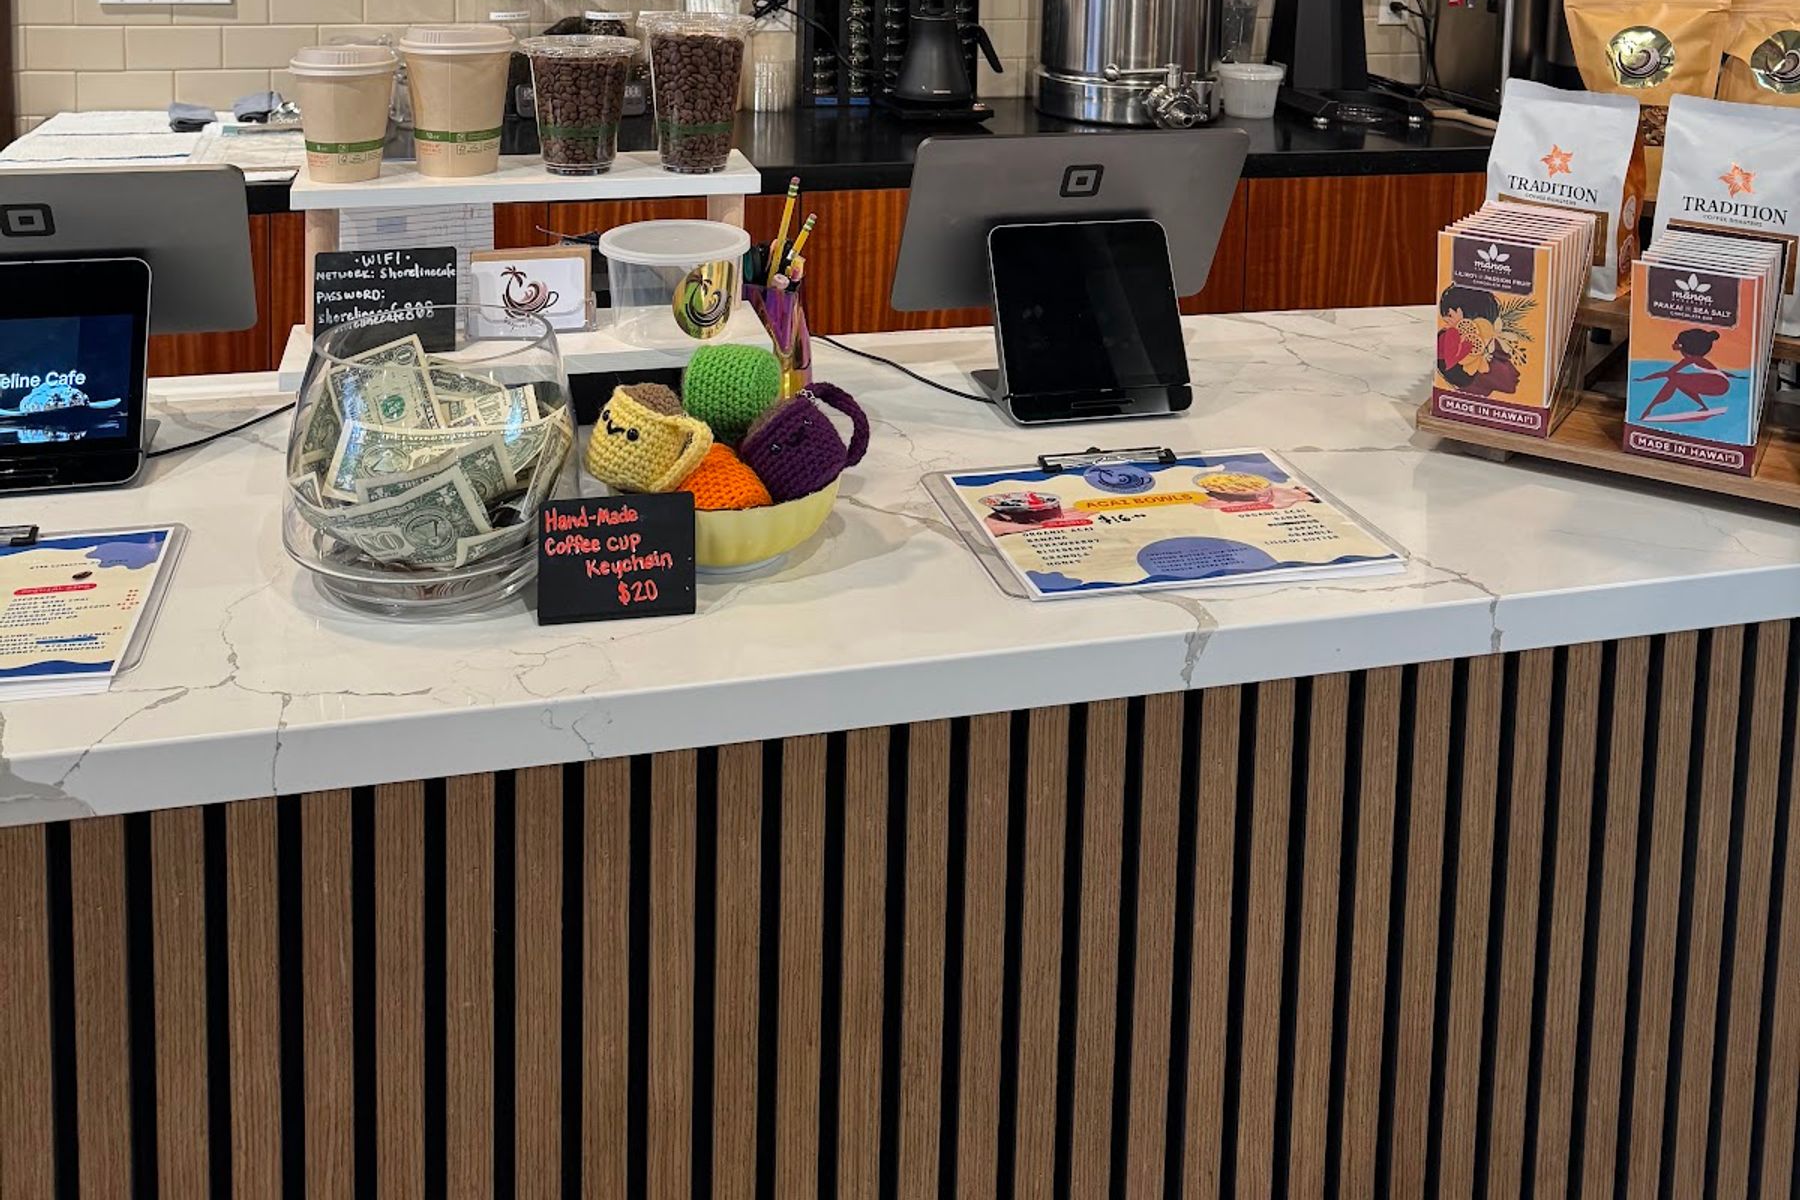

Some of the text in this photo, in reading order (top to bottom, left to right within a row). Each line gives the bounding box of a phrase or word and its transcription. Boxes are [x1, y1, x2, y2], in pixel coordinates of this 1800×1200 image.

[1508, 175, 1598, 203] TRADITION
[1682, 196, 1788, 225] TRADITION
[1693, 307, 1732, 318] SEA SALT
[0, 370, 86, 389] eline Cafe
[1446, 400, 1474, 412] MADE
[1478, 406, 1489, 416] IN
[1638, 438, 1670, 451] MADE
[1674, 444, 1686, 454] IN
[1135, 494, 1192, 504] BOWLS
[544, 534, 601, 556] Coffee
[584, 551, 673, 579] Keychain
[617, 579, 658, 606] $20
